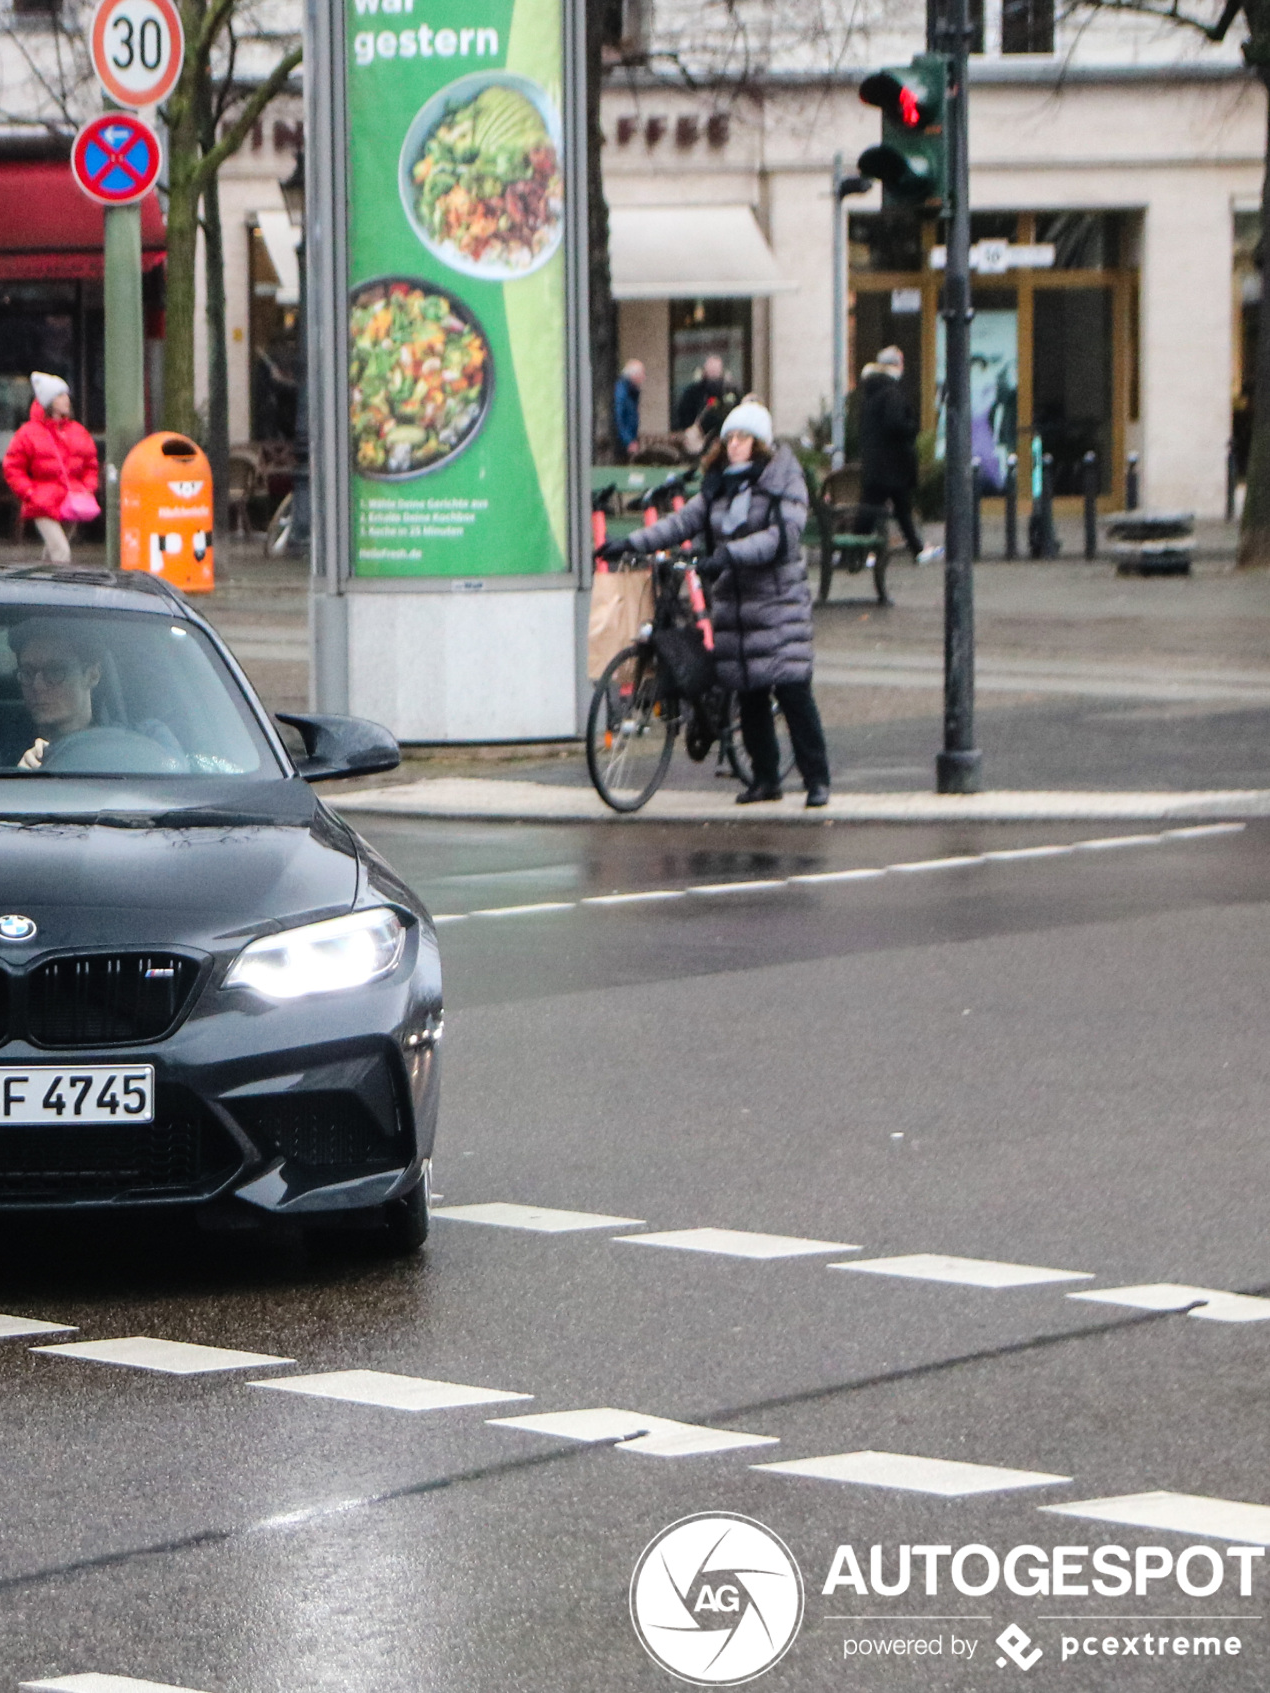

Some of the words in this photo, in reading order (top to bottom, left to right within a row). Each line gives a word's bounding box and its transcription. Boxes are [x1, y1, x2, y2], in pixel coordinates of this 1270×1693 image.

[112, 16, 162, 70] 30
[354, 24, 499, 66] gestern
[42, 1073, 148, 1116] 4745
